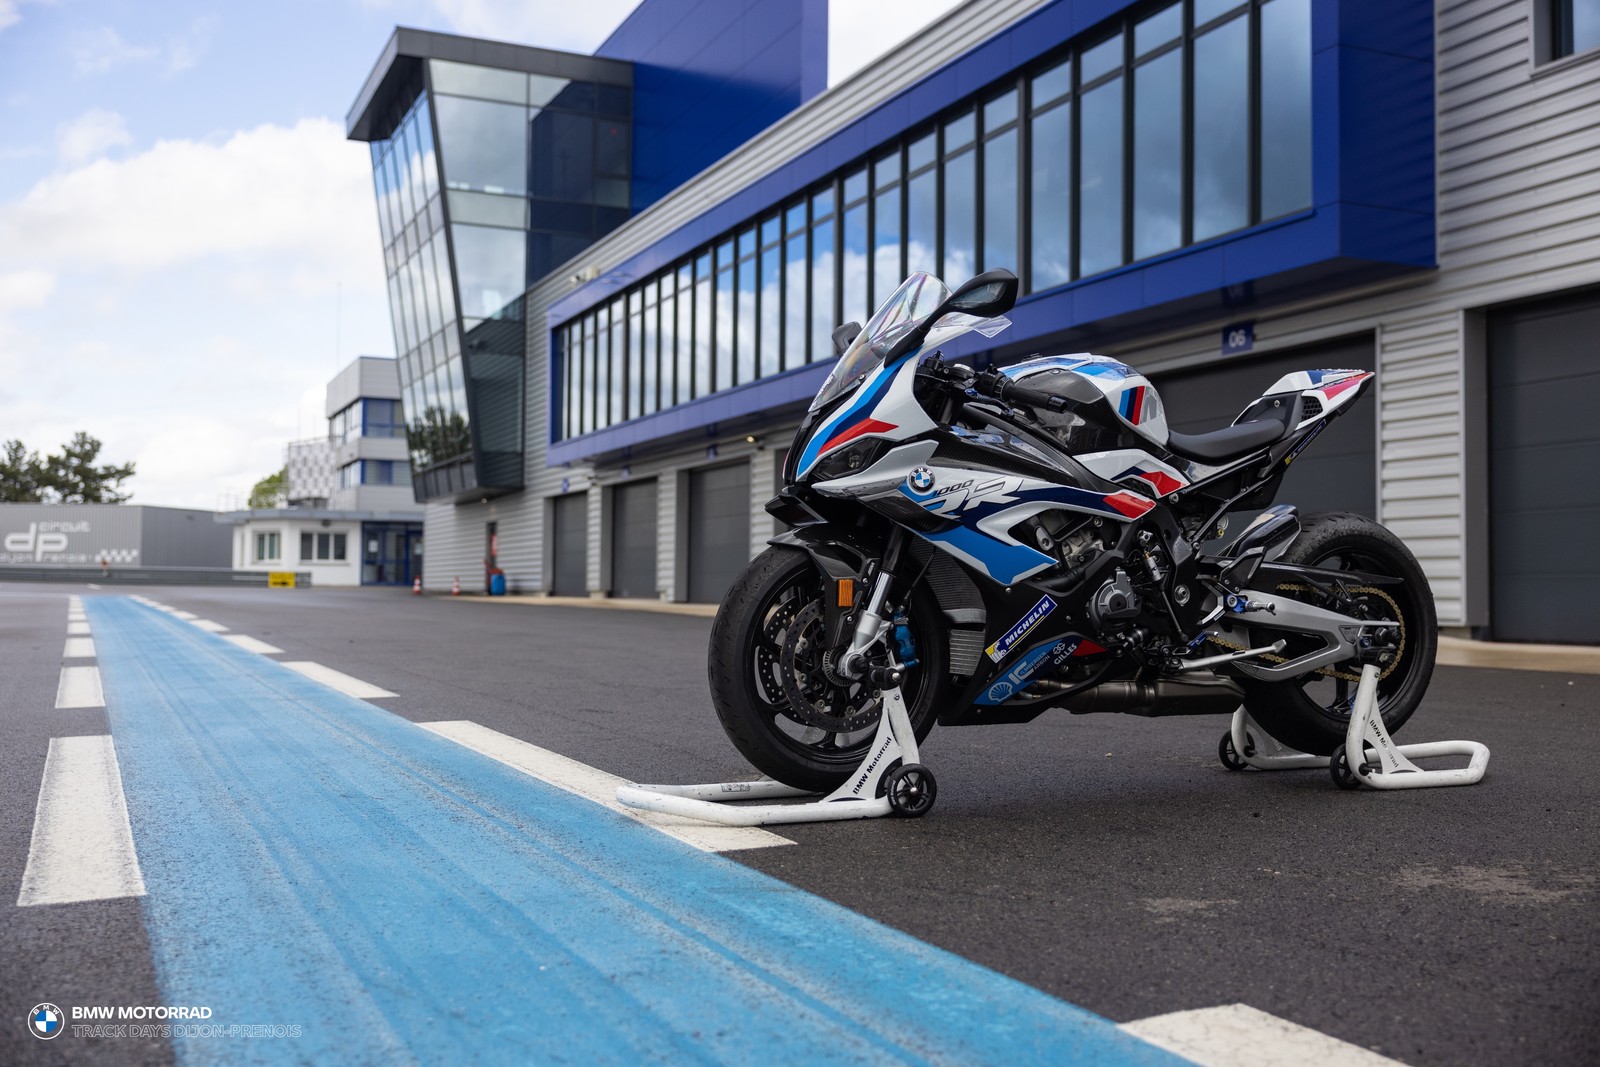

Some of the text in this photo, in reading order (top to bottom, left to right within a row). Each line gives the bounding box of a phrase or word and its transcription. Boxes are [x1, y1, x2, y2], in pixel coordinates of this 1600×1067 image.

[1228, 329, 1246, 348] 06
[932, 479, 974, 497] 1000
[4, 522, 68, 562] dp
[1004, 600, 1050, 646] MICHELIN
[1053, 643, 1078, 665] GILLES
[1369, 719, 1399, 768] BMW Morrad
[852, 736, 892, 795] BMW Motorrad
